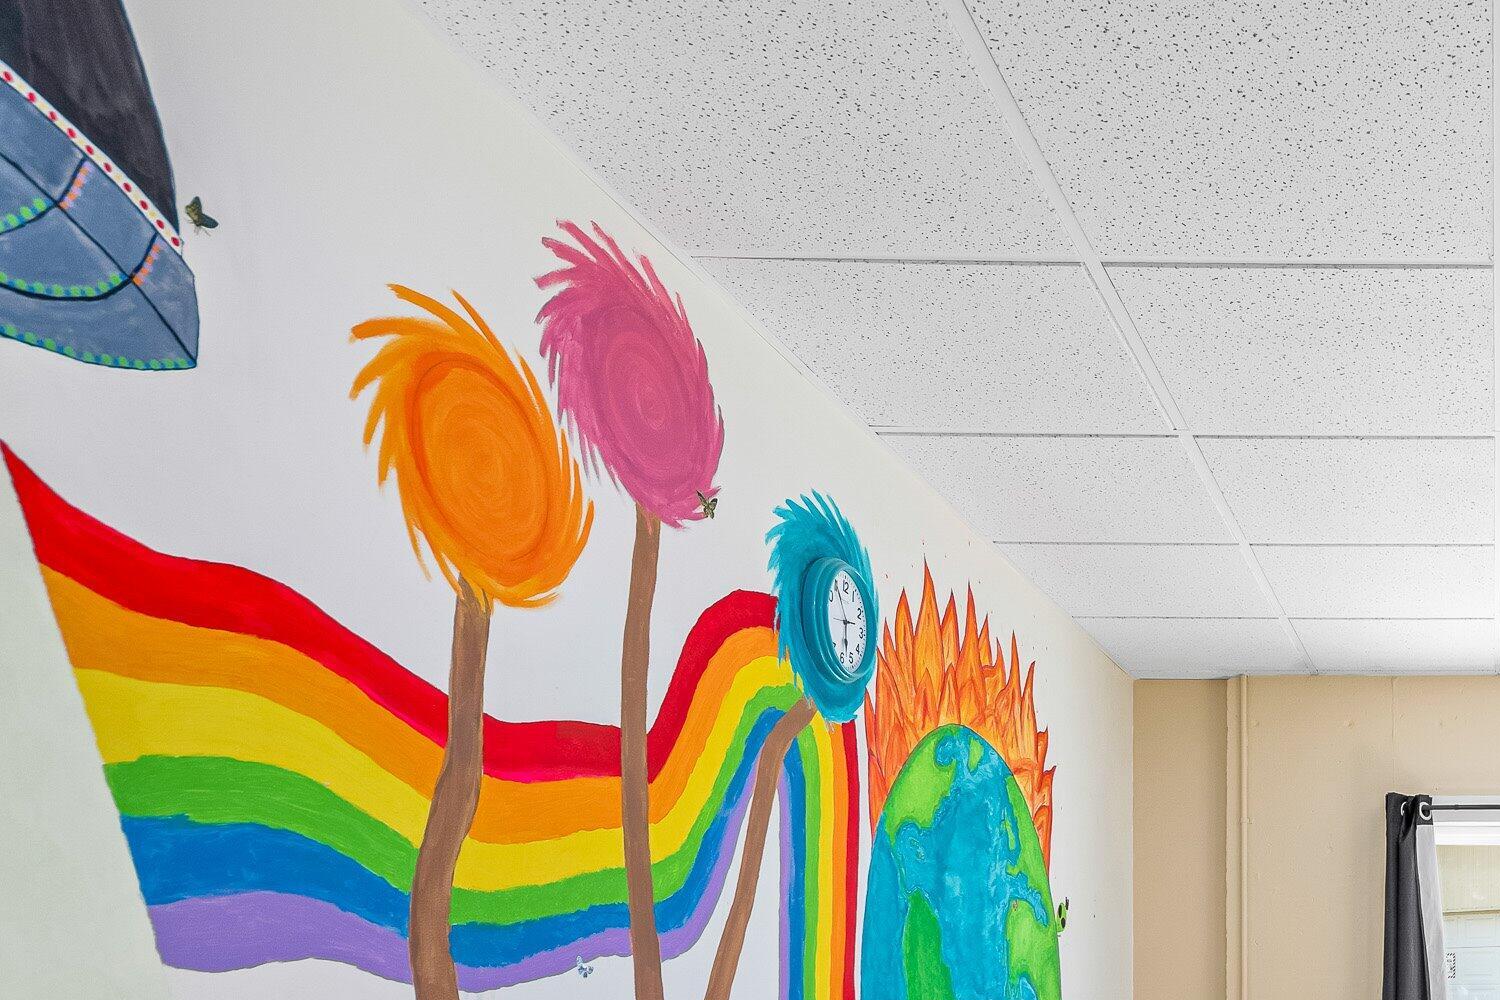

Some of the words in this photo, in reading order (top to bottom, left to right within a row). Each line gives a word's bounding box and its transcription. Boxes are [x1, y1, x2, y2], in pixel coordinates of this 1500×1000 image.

[843, 580, 849, 594] 12
[857, 607, 862, 620] 2
[859, 627, 864, 639] 3
[849, 651, 854, 664] 5
